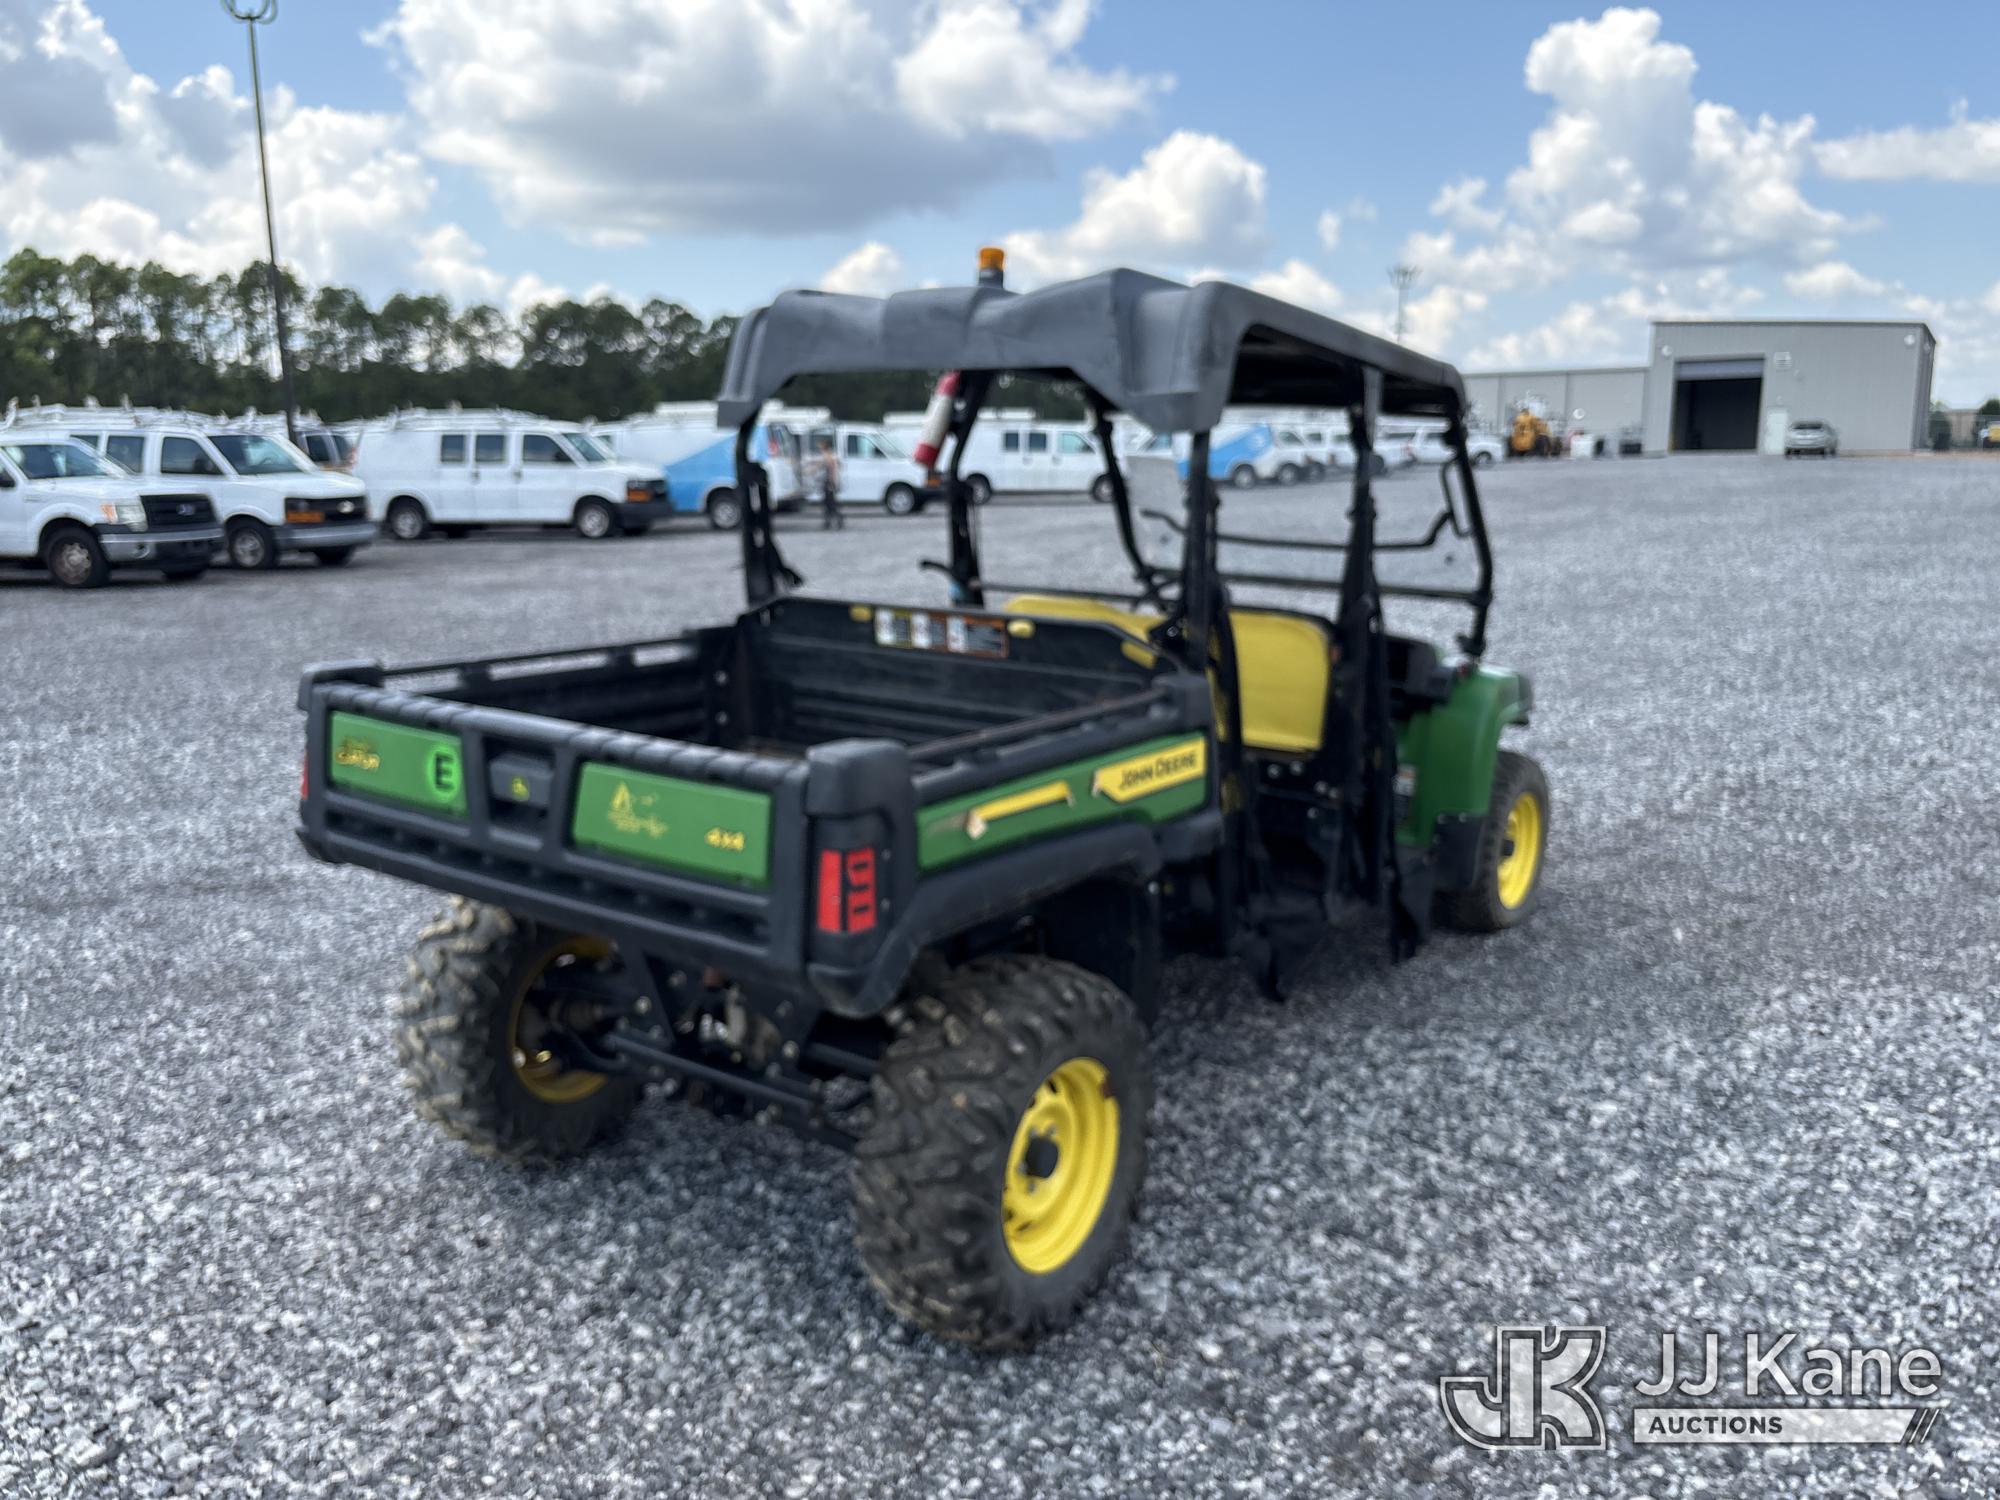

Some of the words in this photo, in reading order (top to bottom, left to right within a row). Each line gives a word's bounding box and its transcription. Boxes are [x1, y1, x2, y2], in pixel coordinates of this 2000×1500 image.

[434, 752, 455, 790] E
[1119, 765, 1153, 790] JOHN
[1154, 750, 1197, 778] DEERE
